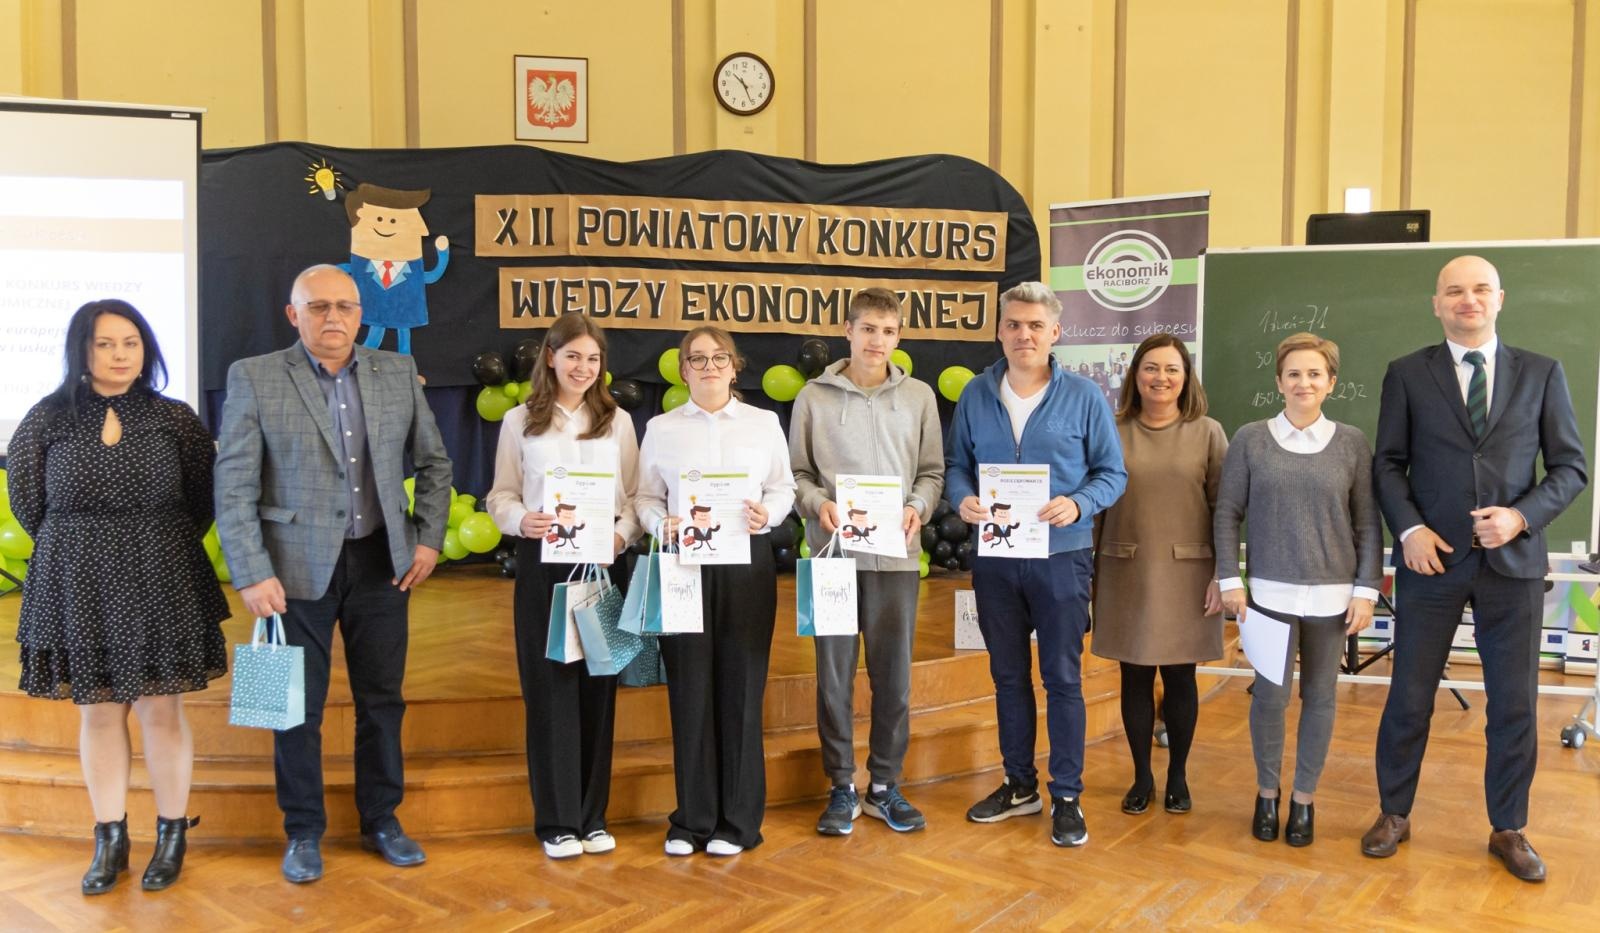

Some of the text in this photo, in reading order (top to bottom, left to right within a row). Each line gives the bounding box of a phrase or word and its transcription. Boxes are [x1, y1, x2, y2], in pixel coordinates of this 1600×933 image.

[576, 205, 805, 252] POWIATOWY
[816, 215, 997, 262] KONKURS
[1086, 262, 1169, 280] ekonomik
[511, 277, 989, 331] WIEDZY EKONOMINEJ
[1111, 322, 1129, 337] do
[1133, 321, 1197, 336] sukcesu
[1255, 351, 1273, 369] 30
